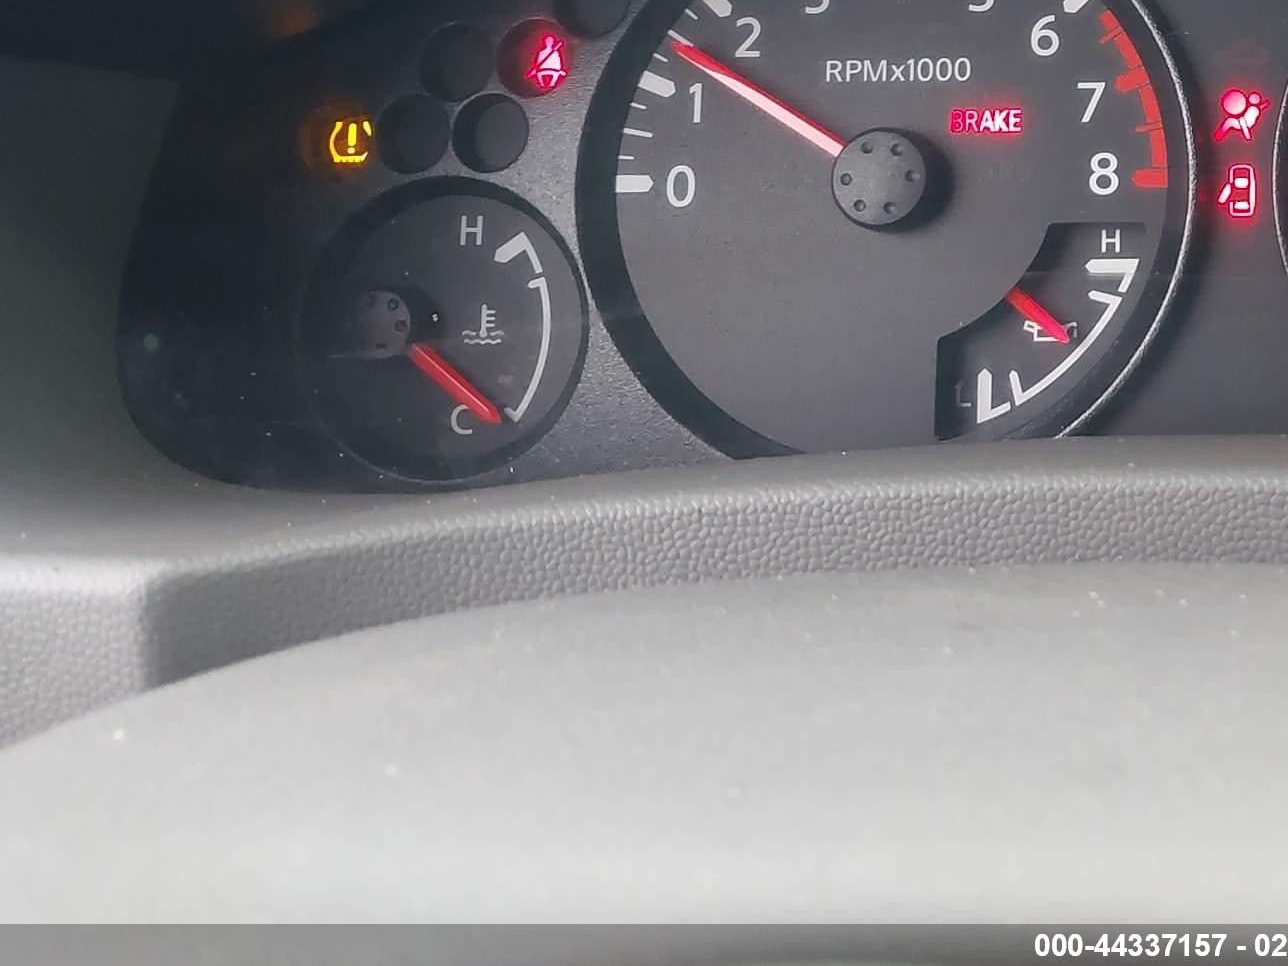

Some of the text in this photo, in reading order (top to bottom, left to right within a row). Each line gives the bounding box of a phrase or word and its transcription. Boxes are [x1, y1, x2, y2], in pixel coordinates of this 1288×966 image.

[734, 17, 761, 58] 2
[1030, 15, 1060, 57] 6
[825, 57, 972, 83] RPMx1000
[689, 82, 703, 123] 1
[950, 109, 1022, 133] BRAKE
[1077, 81, 1106, 123] 7
[666, 165, 696, 208] 0
[1089, 152, 1120, 195] 8
[460, 215, 484, 246] H
[1101, 229, 1121, 253] H
[450, 404, 473, 435] C
